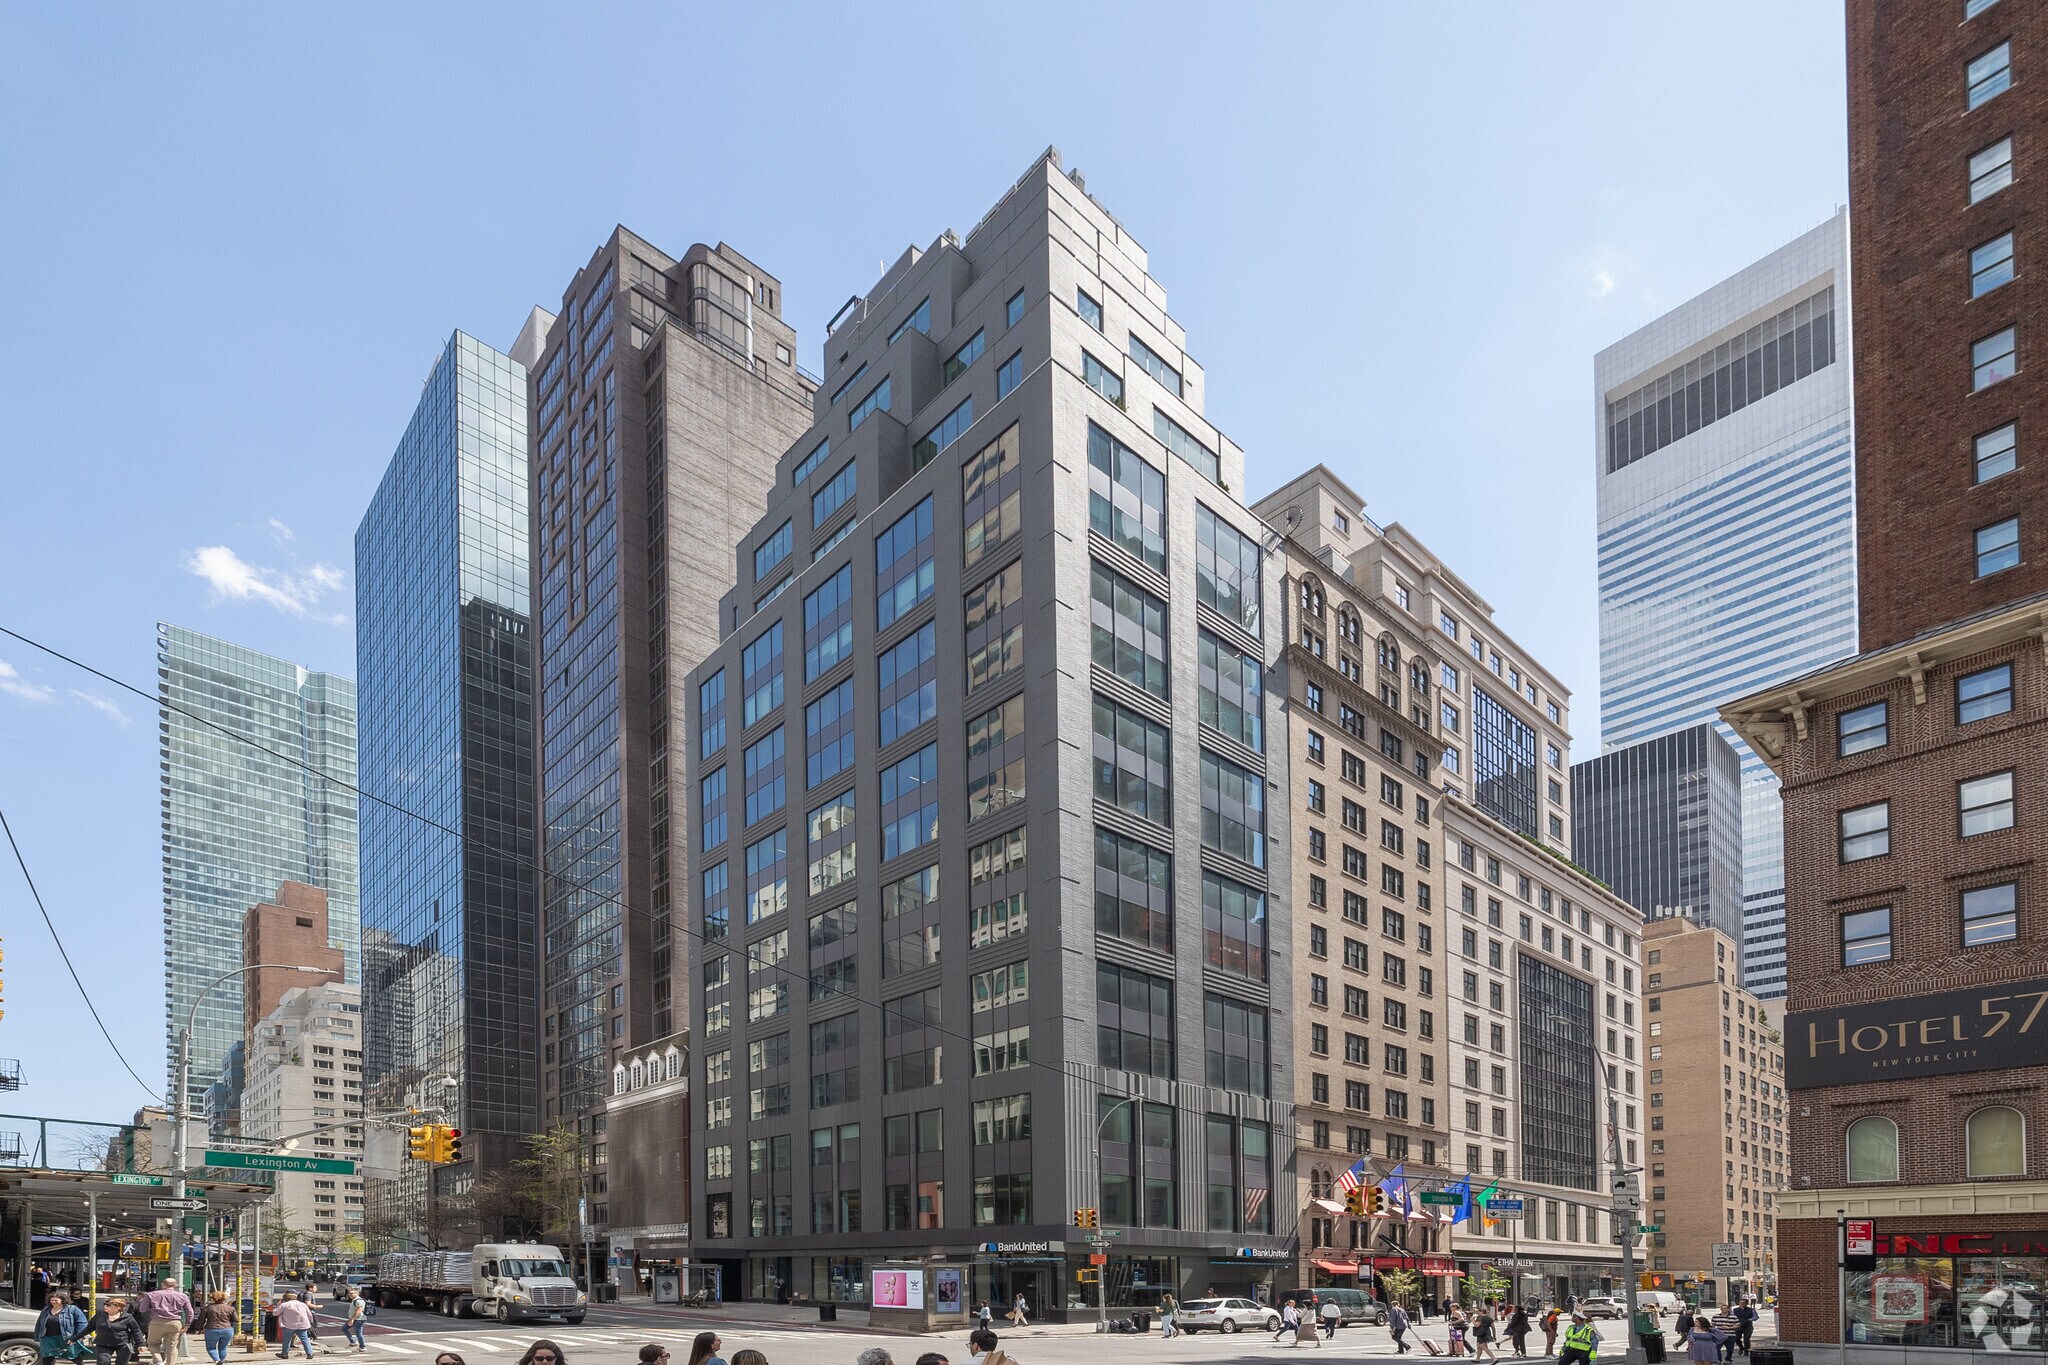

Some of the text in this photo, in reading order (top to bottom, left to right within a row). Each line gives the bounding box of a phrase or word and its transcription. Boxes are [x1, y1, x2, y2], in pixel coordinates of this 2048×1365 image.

[1808, 991, 2048, 1058] HOTEL 57
[1872, 1050, 1978, 1068] NEW YORK CITY
[245, 1156, 318, 1169] Lexington Av
[114, 1175, 151, 1185] LEXINGTON
[189, 1188, 197, 1197] 57
[998, 1241, 1047, 1252] BankUnited
[1876, 1235, 1992, 1254] NC
[1252, 1248, 1289, 1258] BankUnited
[1516, 1259, 1534, 1267] ALLEN
[1716, 1257, 1740, 1266] 25
